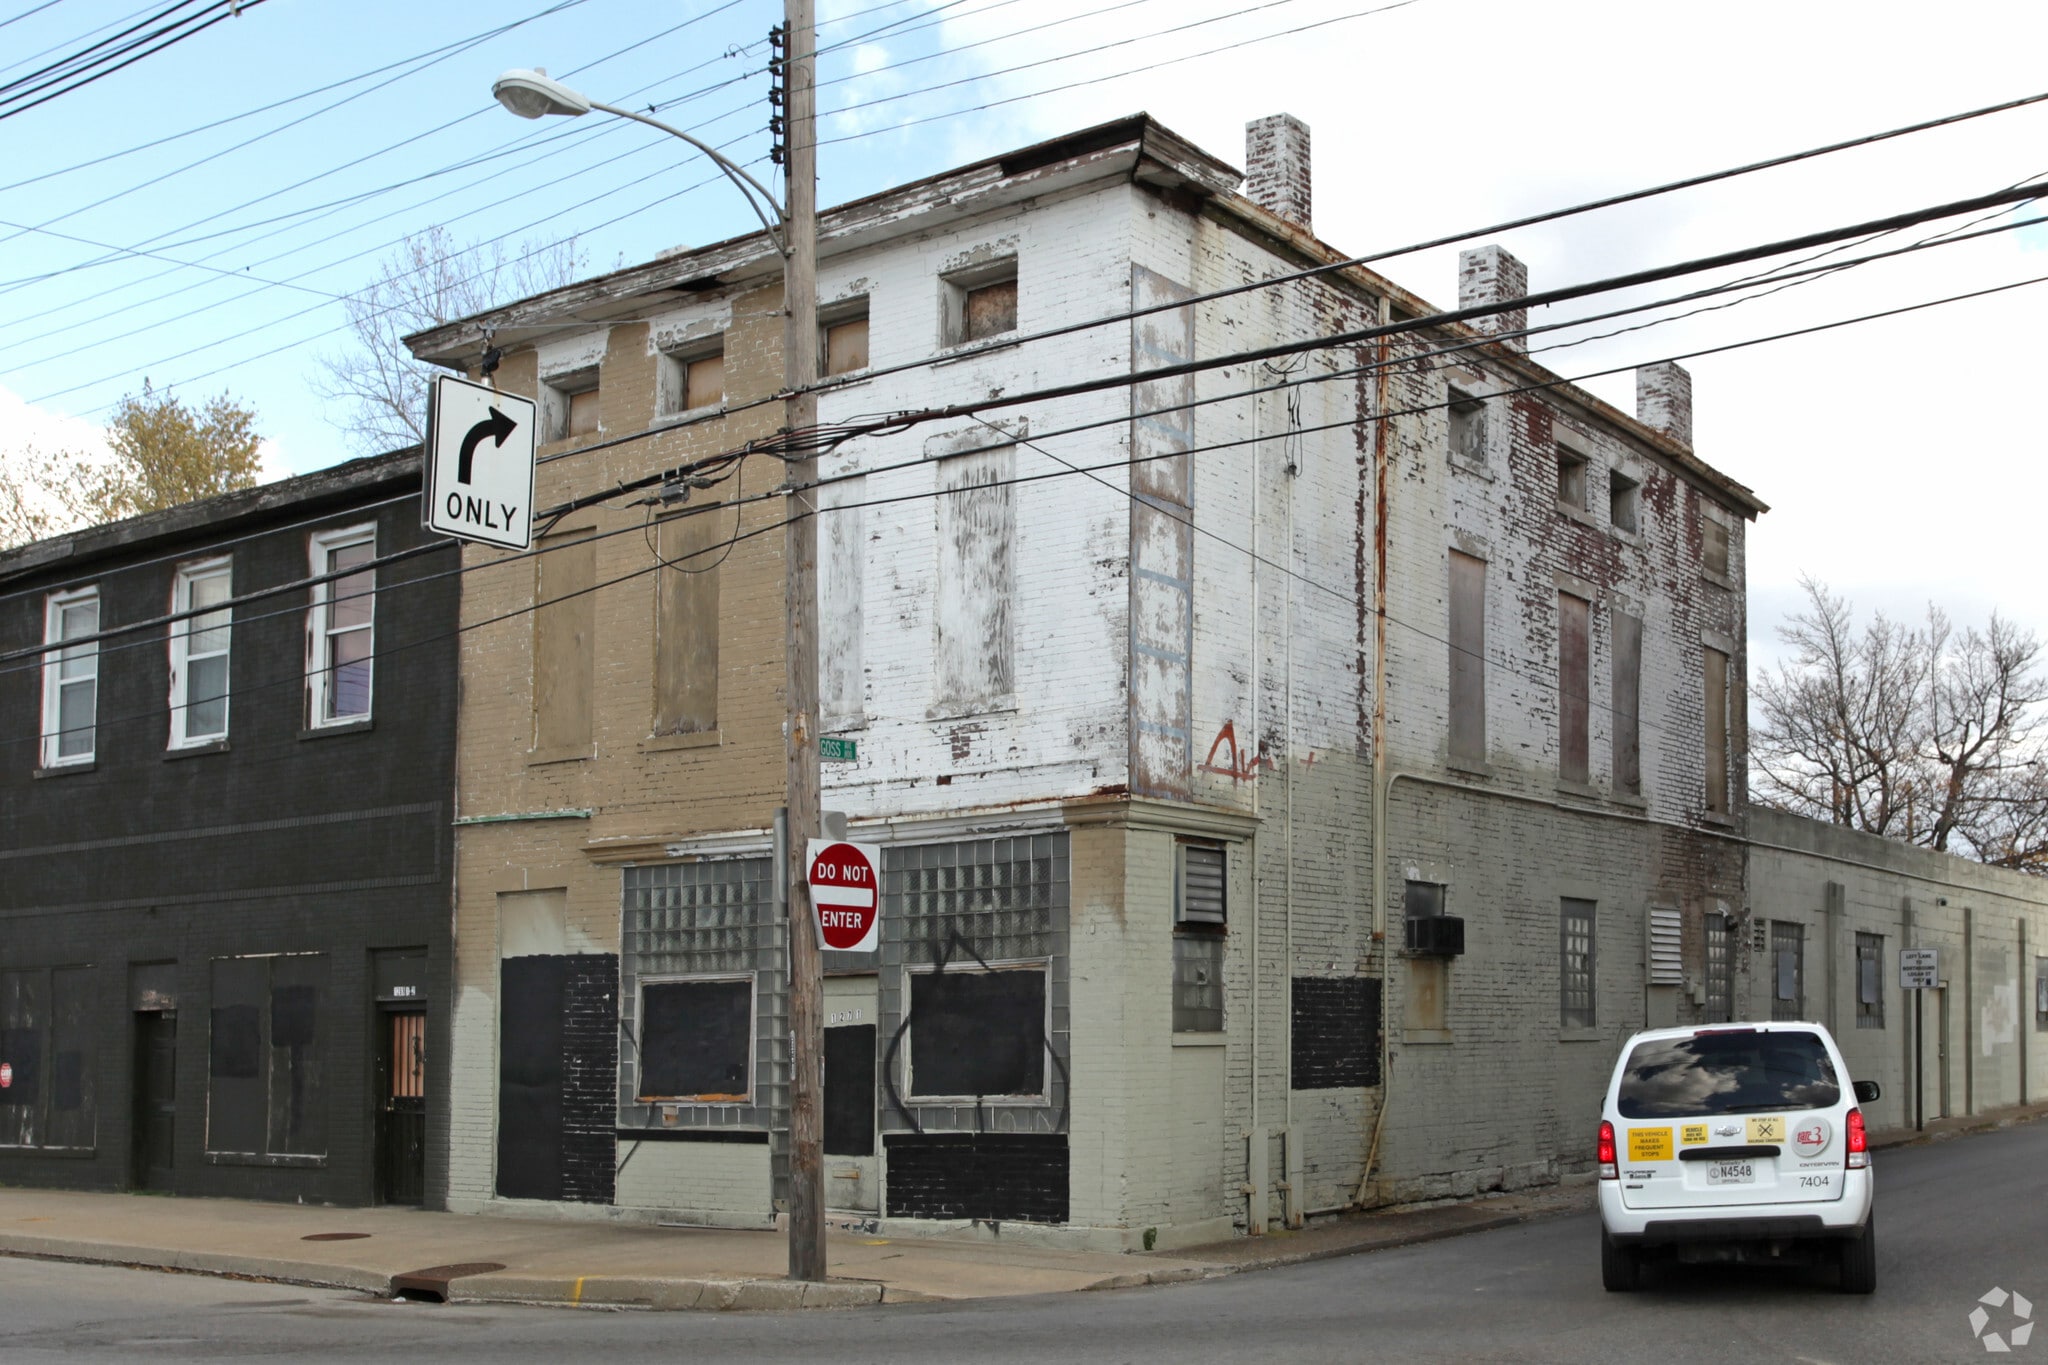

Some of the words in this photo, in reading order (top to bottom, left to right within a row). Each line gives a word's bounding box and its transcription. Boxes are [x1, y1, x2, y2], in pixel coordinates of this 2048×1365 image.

[446, 492, 517, 532] ONLY
[820, 739, 842, 757] GOSS
[817, 862, 836, 880] DO
[842, 865, 869, 883] NOT
[821, 911, 862, 930] ENTER
[831, 1009, 861, 1024] 1271
[1721, 1165, 1752, 1178] N4548
[1799, 1176, 1829, 1188] 7404
